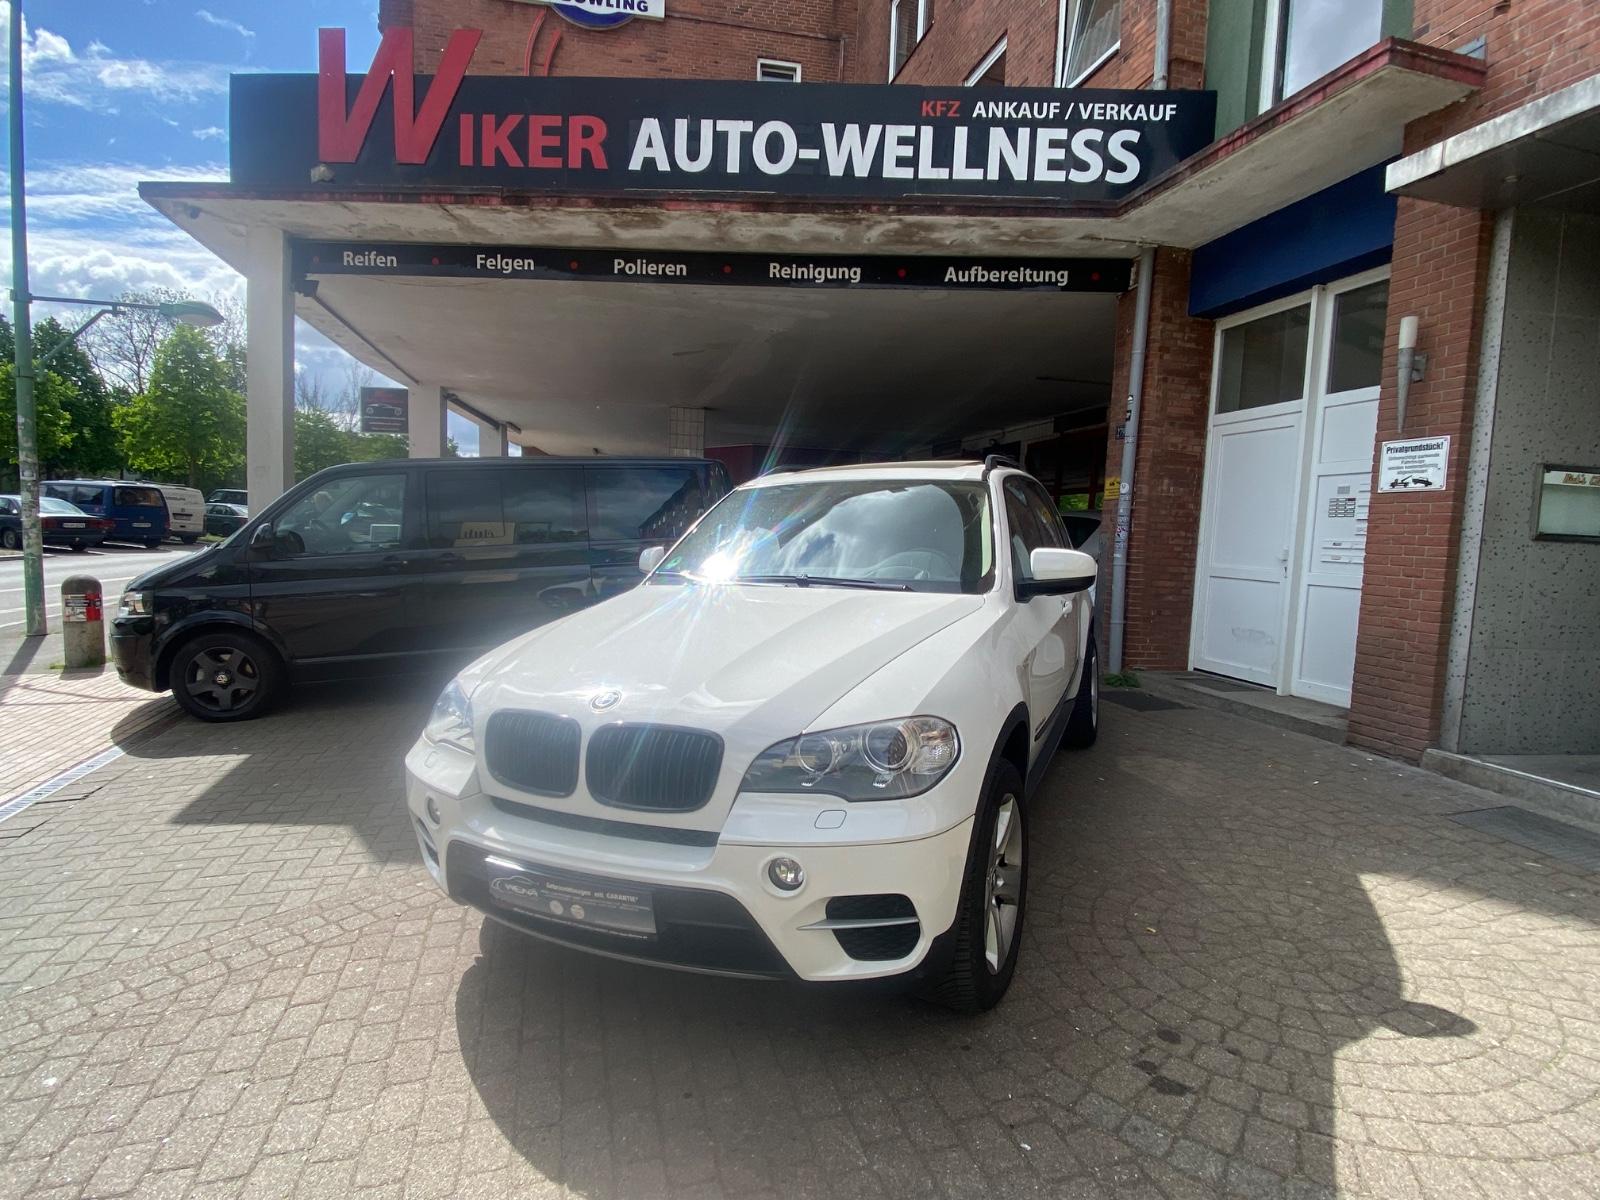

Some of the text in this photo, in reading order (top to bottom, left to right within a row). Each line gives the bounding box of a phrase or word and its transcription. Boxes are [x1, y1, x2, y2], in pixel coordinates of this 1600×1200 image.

[921, 100, 960, 117] KFZ
[972, 101, 1060, 119] ANKAUF
[1079, 103, 1177, 121] VERKAUF
[628, 117, 1141, 184] AUTO-WELLNESS
[343, 251, 1069, 287] Reifen Felgen Polieren Reinigung Aufbereitung
